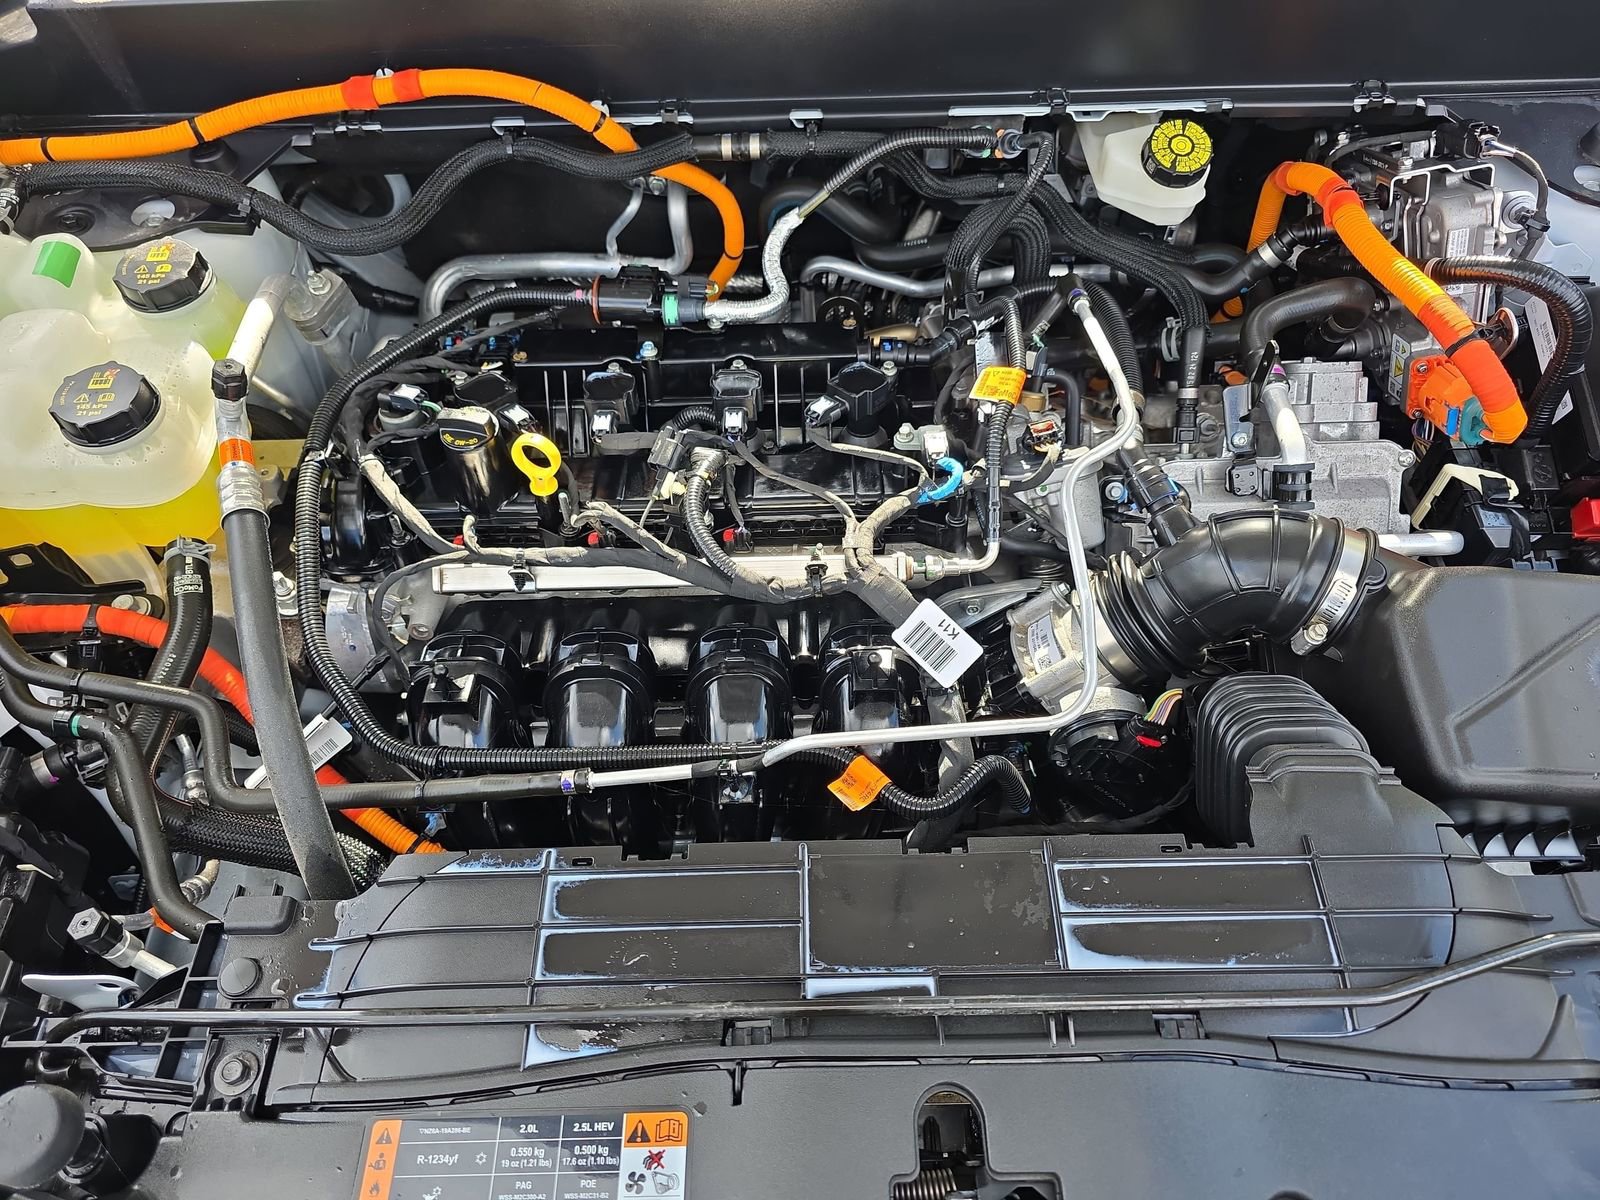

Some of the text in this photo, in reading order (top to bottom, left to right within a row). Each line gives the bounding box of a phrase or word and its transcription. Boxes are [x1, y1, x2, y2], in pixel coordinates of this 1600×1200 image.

[938, 618, 960, 640] K11
[519, 1124, 539, 1133] 2.0L
[572, 1122, 614, 1132] 2.5L HEV
[510, 1147, 545, 1159] 0.550 kg
[574, 1145, 609, 1156] 0.500 kg
[417, 1154, 459, 1166] R-1234yf
[520, 1160, 538, 1168] (1.21
[538, 1159, 552, 1168] lbs)
[562, 1157, 577, 1166] 17.6
[588, 1156, 604, 1166] (1.10
[606, 1156, 620, 1166] lbs)
[515, 1181, 532, 1190] PAG
[580, 1180, 597, 1188] POE
